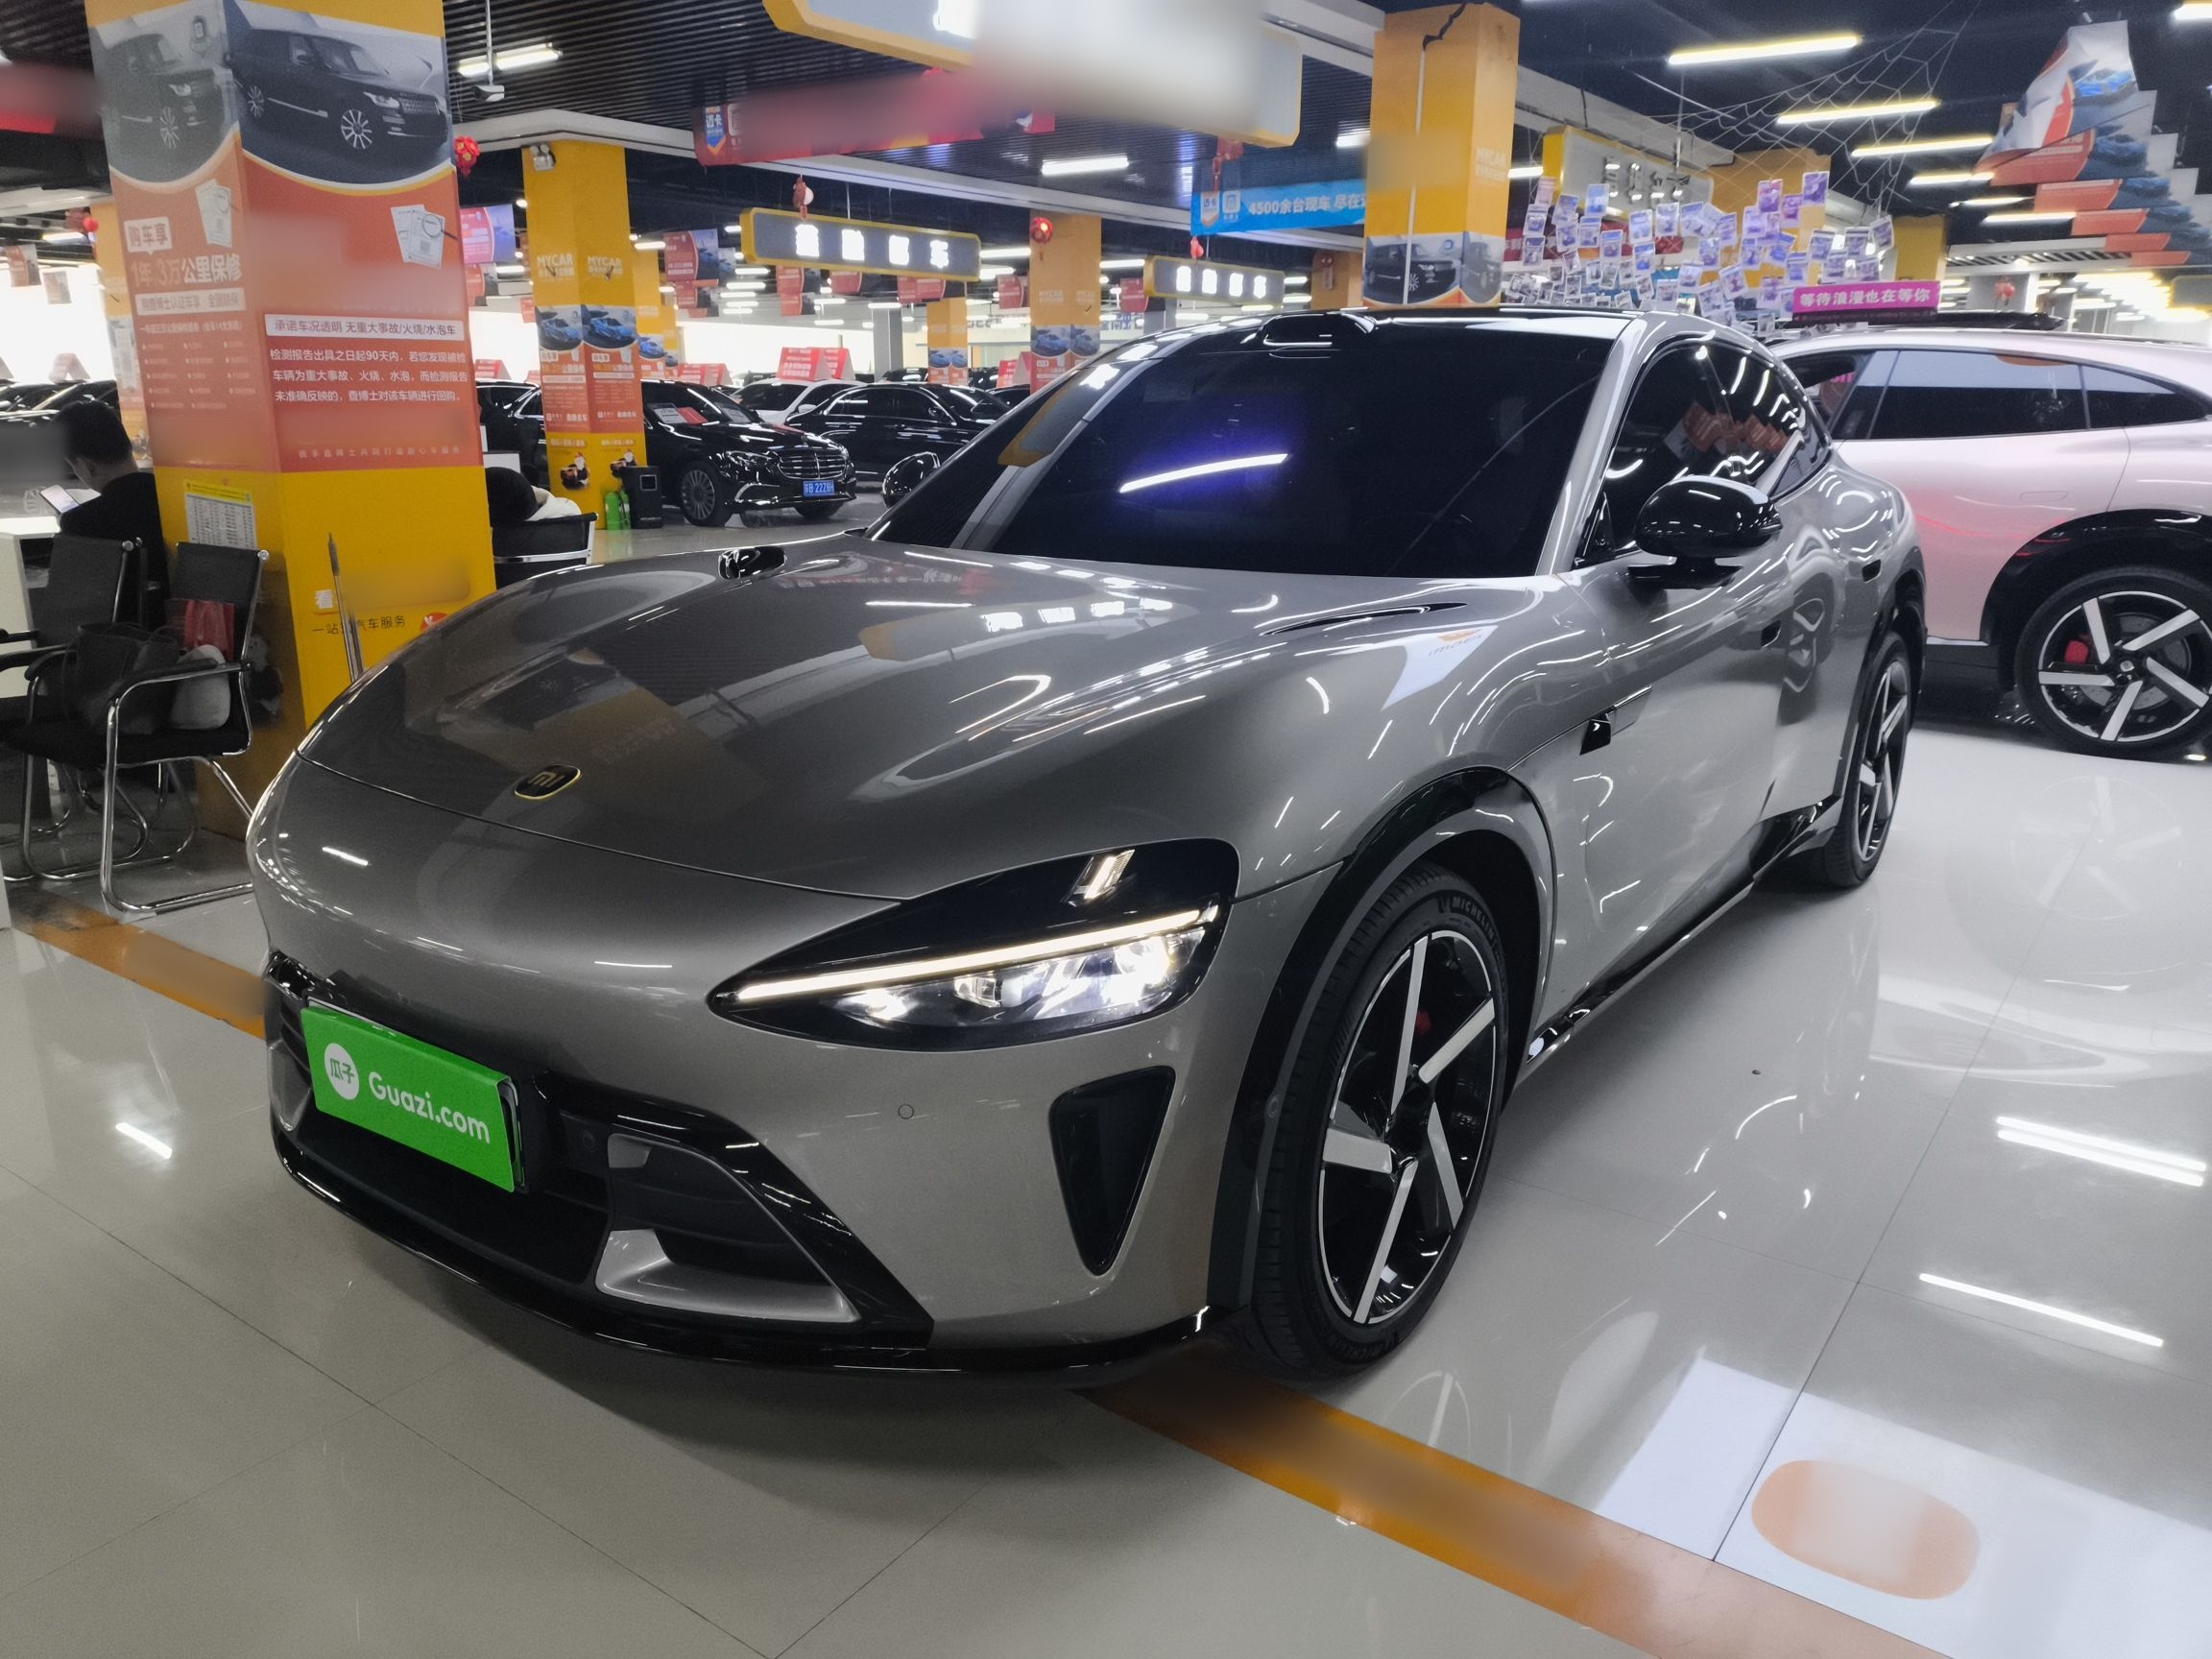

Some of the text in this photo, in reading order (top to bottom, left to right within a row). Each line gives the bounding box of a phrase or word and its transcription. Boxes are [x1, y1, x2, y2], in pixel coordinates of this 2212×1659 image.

[1248, 195, 1332, 216] 4500余台现车
[1799, 288, 1931, 307] 等待浪漫也在等你
[275, 320, 456, 336] 承诺车况透明 无重大事故/火烧/水泡车
[312, 614, 406, 636] 一站汽车服务
[329, 1057, 355, 1084] 瓜子
[368, 1070, 491, 1145] Guazi.com
